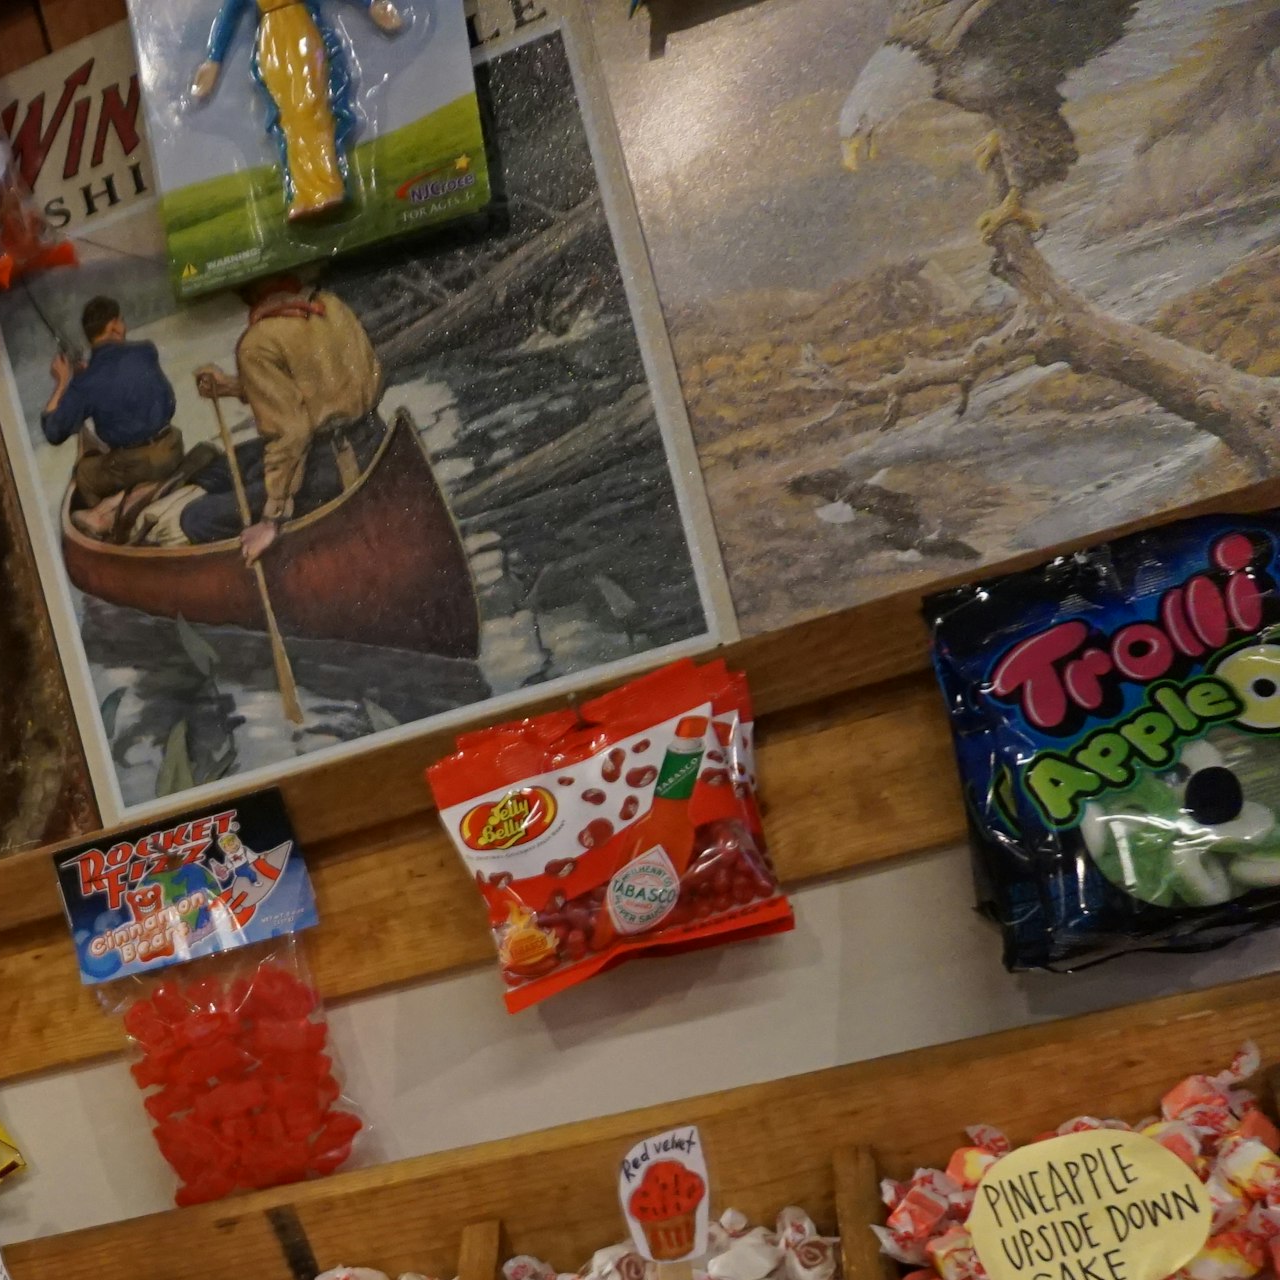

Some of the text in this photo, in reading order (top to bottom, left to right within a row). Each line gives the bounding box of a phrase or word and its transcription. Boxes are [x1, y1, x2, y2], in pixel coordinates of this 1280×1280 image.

[990, 532, 1264, 729] Trolli
[656, 756, 700, 794] TABASCO
[1027, 676, 1237, 822] Apple
[477, 815, 528, 849] Belly
[487, 793, 531, 828] Jelly
[58, 808, 238, 897] ROCKET
[88, 887, 207, 958] Cinnamon
[612, 876, 678, 907] TABASCO
[120, 920, 192, 965] Bears
[621, 1129, 697, 1184] Red velvet
[982, 1143, 1139, 1229] PINEAPPLE
[1001, 1183, 1201, 1272] UPSIDE DOWN
